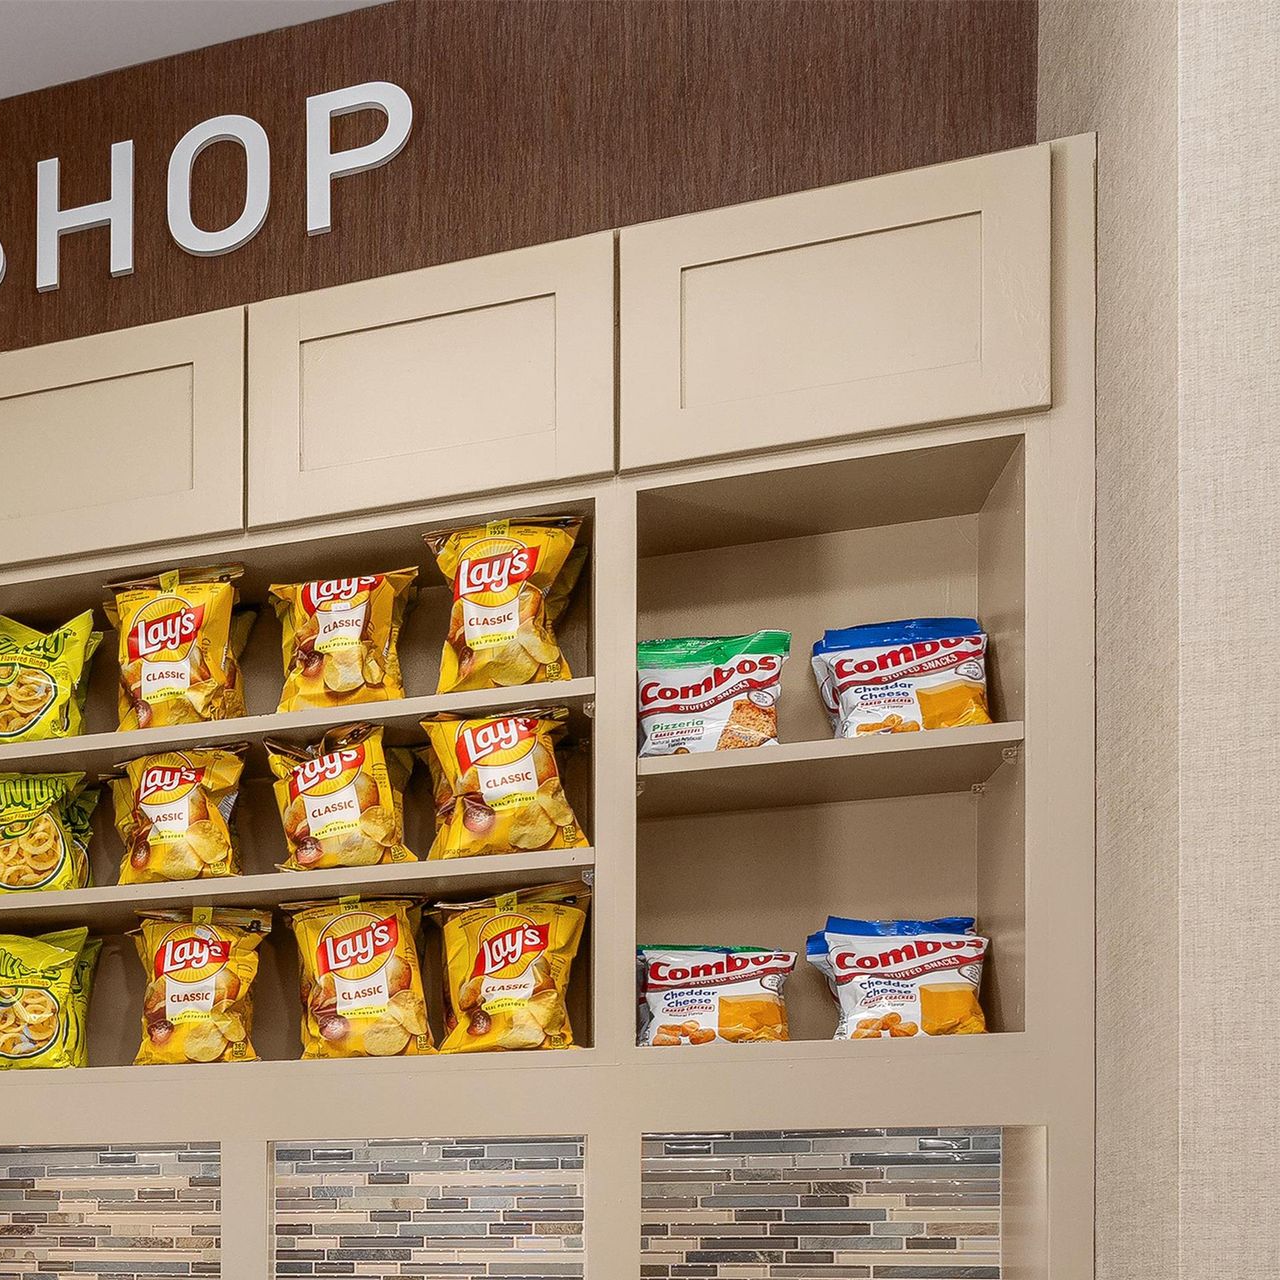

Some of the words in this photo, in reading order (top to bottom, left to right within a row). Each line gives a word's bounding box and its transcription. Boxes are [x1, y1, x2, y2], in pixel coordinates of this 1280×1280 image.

[460, 548, 531, 595] Lay's
[468, 613, 514, 628] CLASSIC
[139, 610, 197, 654] Lay's
[146, 671, 185, 682] CLASSIC
[642, 656, 778, 706] Combos
[679, 698, 714, 712] STUFFED
[718, 682, 749, 701] SNACKS
[652, 719, 703, 731] Pizzeria
[486, 771, 531, 788] CLASSIC
[327, 921, 391, 968] Lay's
[481, 923, 540, 966] Lay's
[341, 985, 383, 999] CLASSIC
[486, 982, 531, 993] CLASSIC
[664, 989, 717, 1001] Cheddar
[170, 992, 211, 1003] CLASSIC
[667, 997, 711, 1008] Cheese
